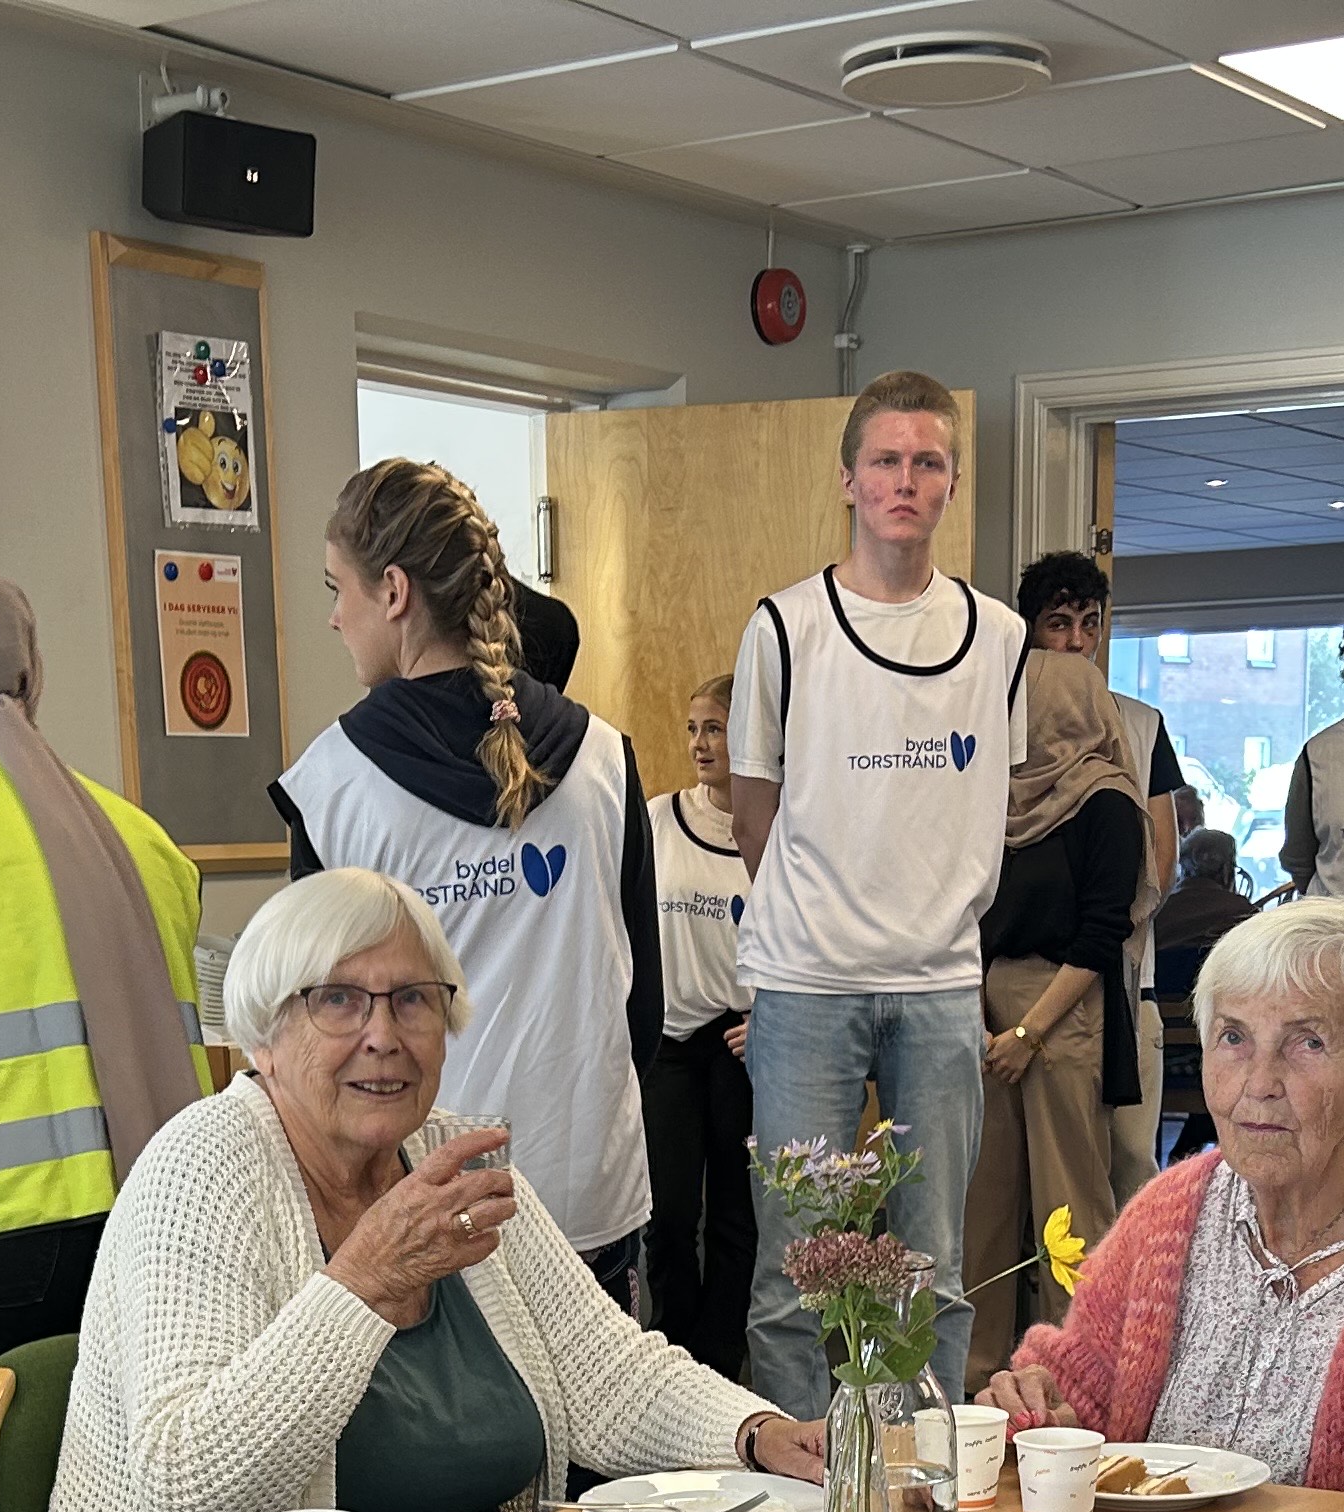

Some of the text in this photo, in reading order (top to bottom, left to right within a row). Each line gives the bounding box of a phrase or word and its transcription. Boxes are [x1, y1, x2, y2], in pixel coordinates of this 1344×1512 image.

[168, 602, 185, 612] DAG
[187, 604, 226, 615] SERVERER
[905, 737, 947, 754] bydel
[847, 755, 947, 770] TORSTRAND
[455, 853, 516, 881] bydel
[694, 891, 729, 908] bydel
